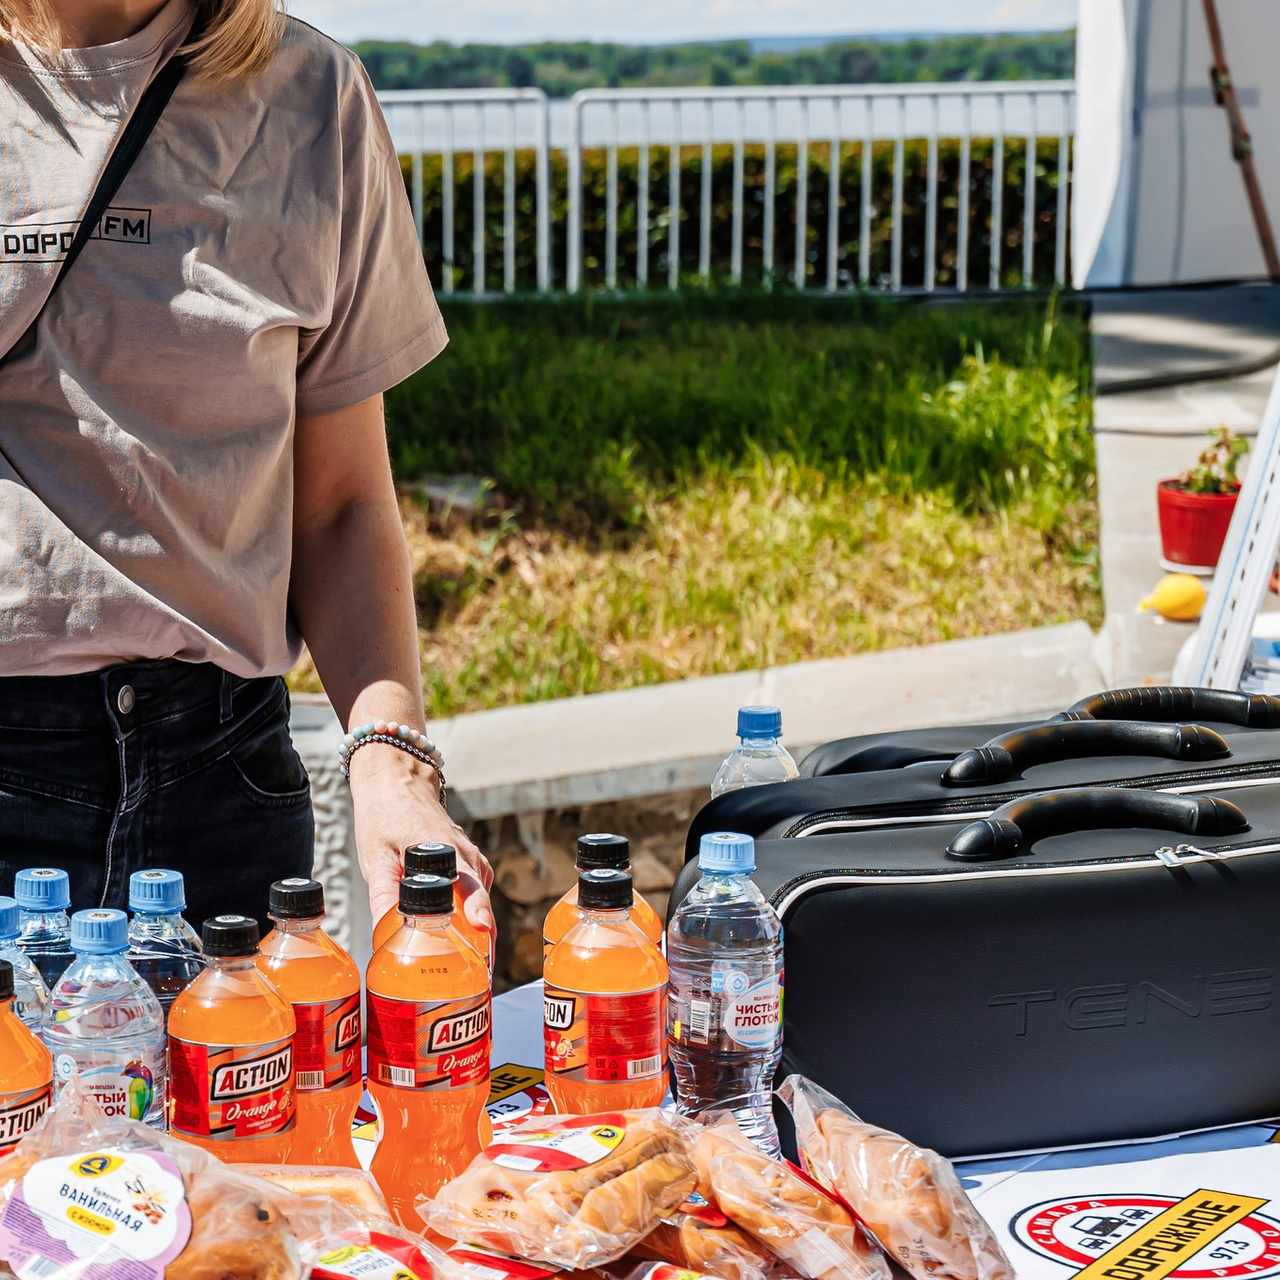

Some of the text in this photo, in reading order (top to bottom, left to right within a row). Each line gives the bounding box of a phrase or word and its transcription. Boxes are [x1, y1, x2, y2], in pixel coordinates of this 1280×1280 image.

[105, 216, 144, 238] FM
[736, 996, 779, 1014] ЧИСТЫЙ
[735, 1014, 778, 1027] ГЛОТОК
[443, 1049, 483, 1072] Orange
[218, 1051, 288, 1093] ACT!ON
[226, 1099, 277, 1121] Orange
[59, 1183, 143, 1232] ВАНИЛЬНАЯ
[1038, 1201, 1107, 1244] САМАРА
[1208, 1239, 1251, 1261] 97.3
